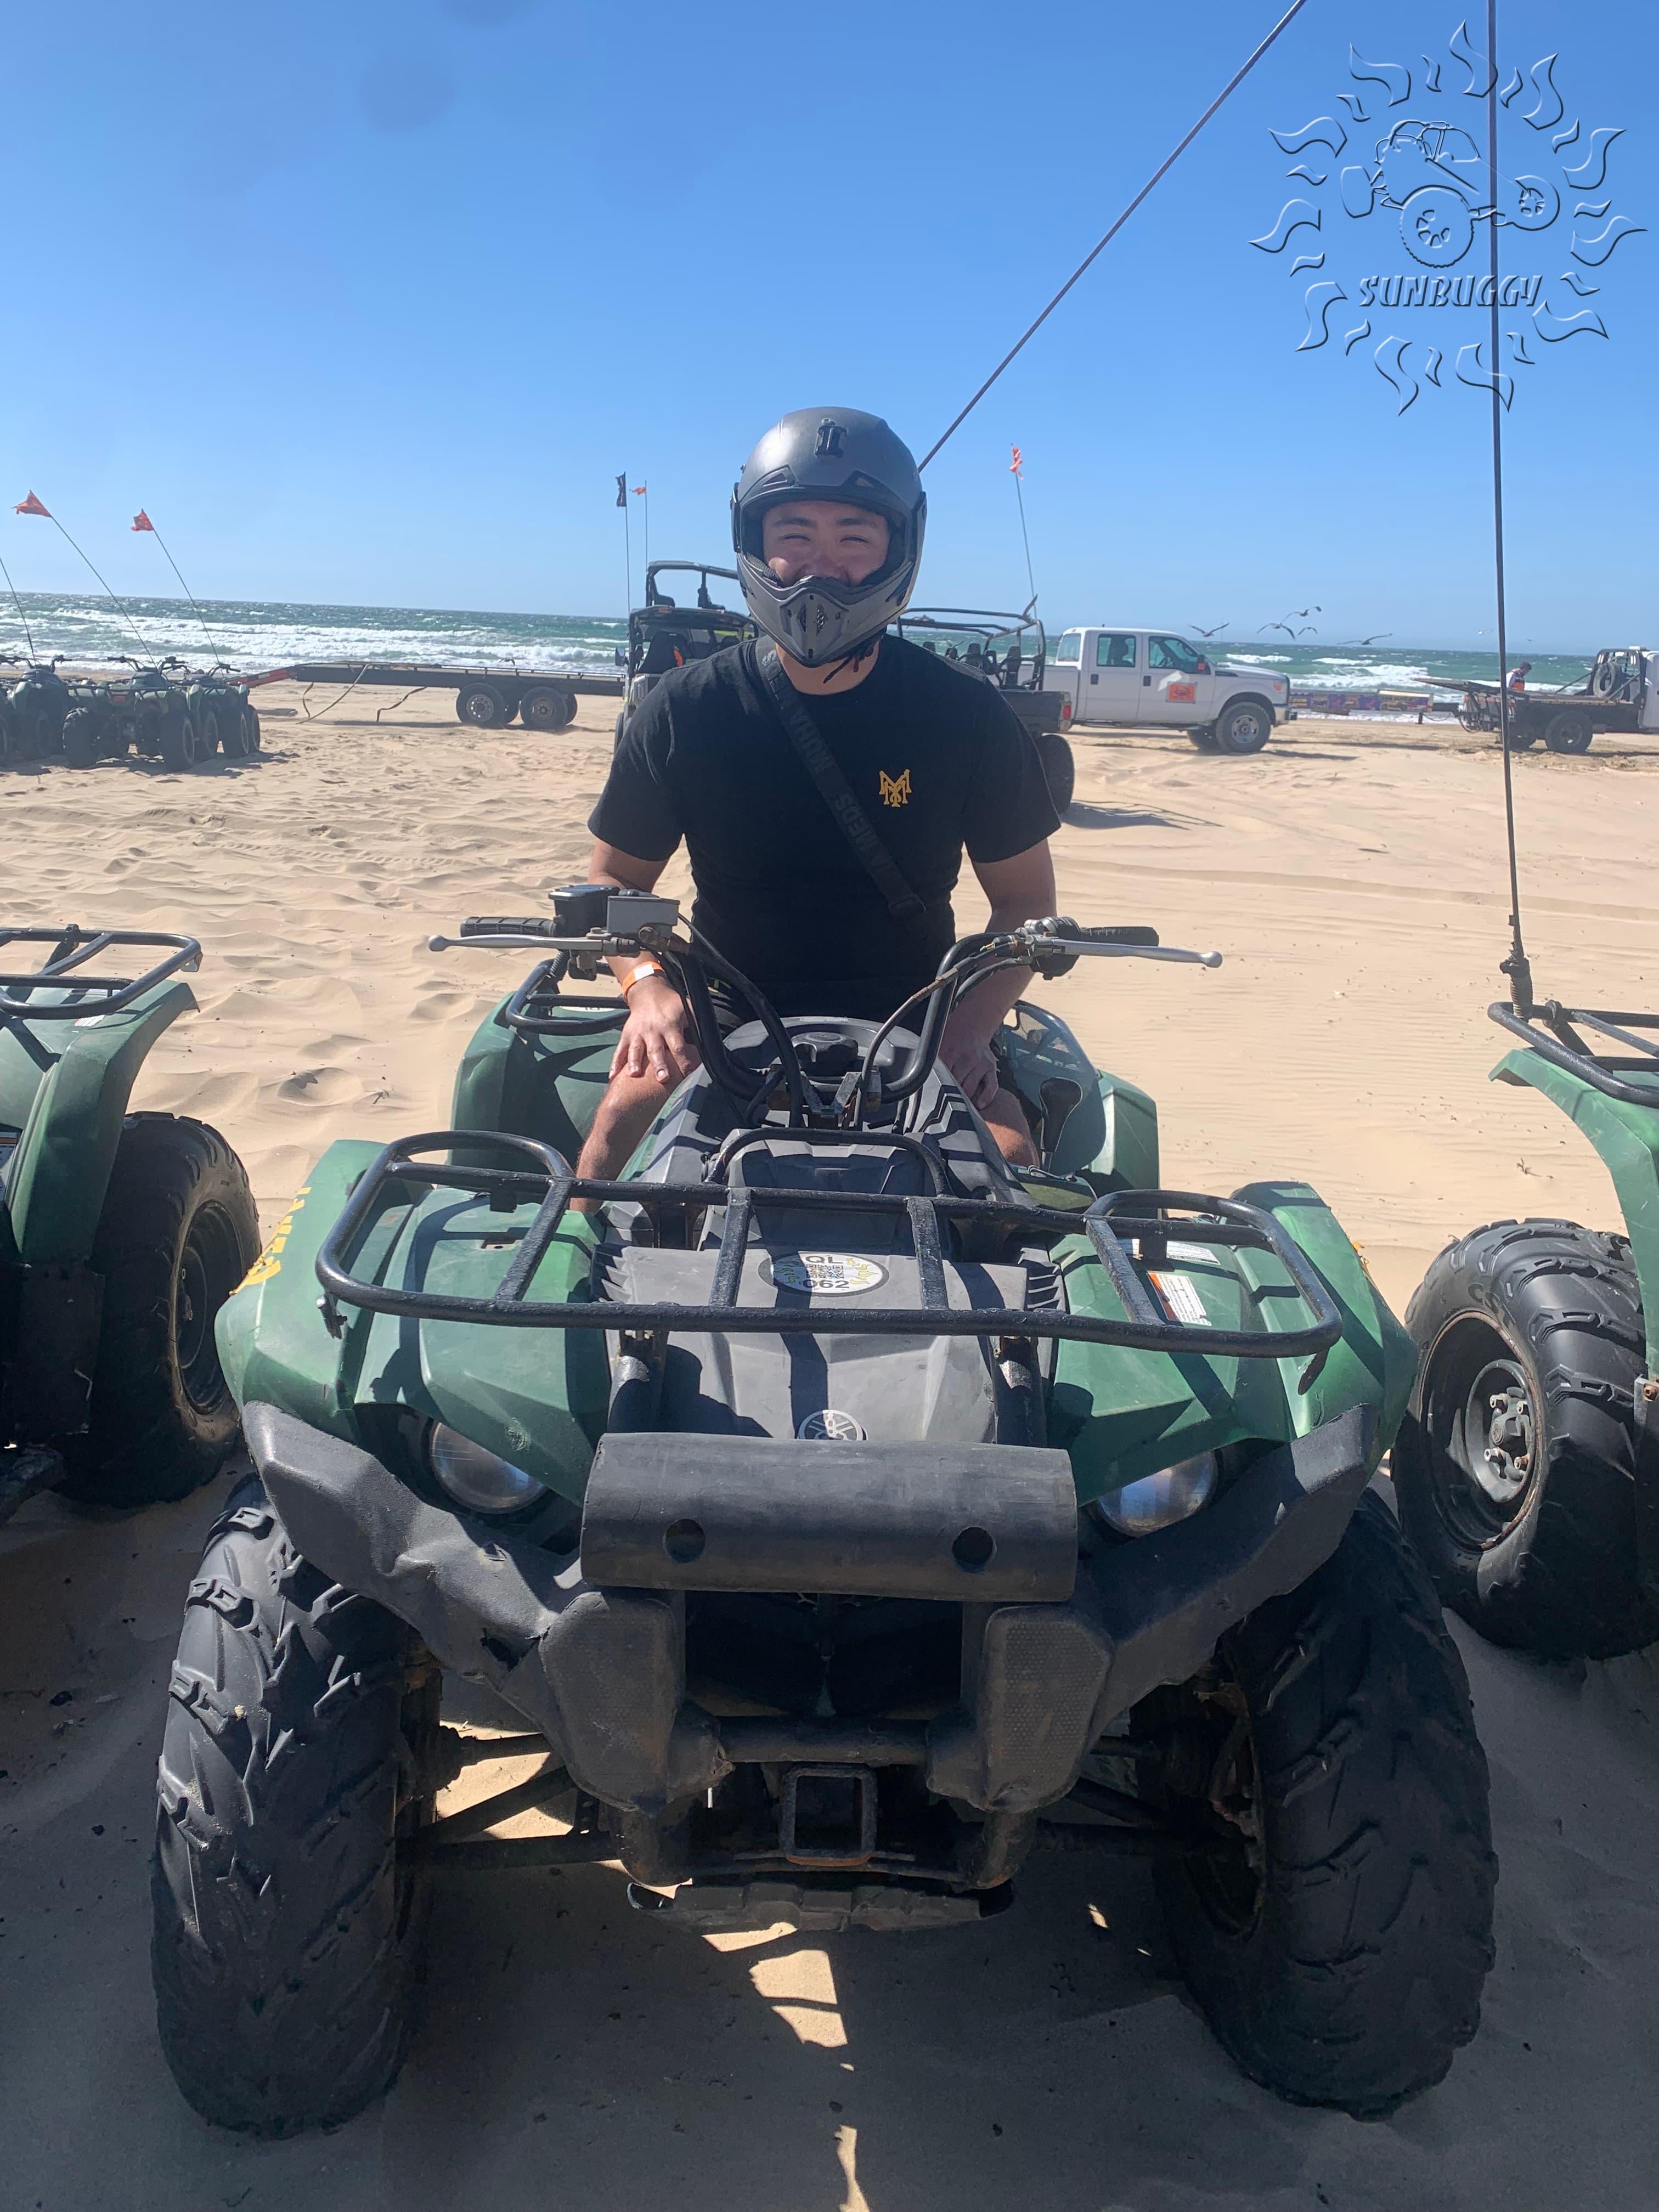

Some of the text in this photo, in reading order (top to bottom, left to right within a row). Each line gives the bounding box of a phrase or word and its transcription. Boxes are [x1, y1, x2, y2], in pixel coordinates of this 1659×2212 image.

[834, 793, 879, 851] MEDS
[805, 1256, 843, 1264] QL
[803, 1279, 850, 1289] 062
